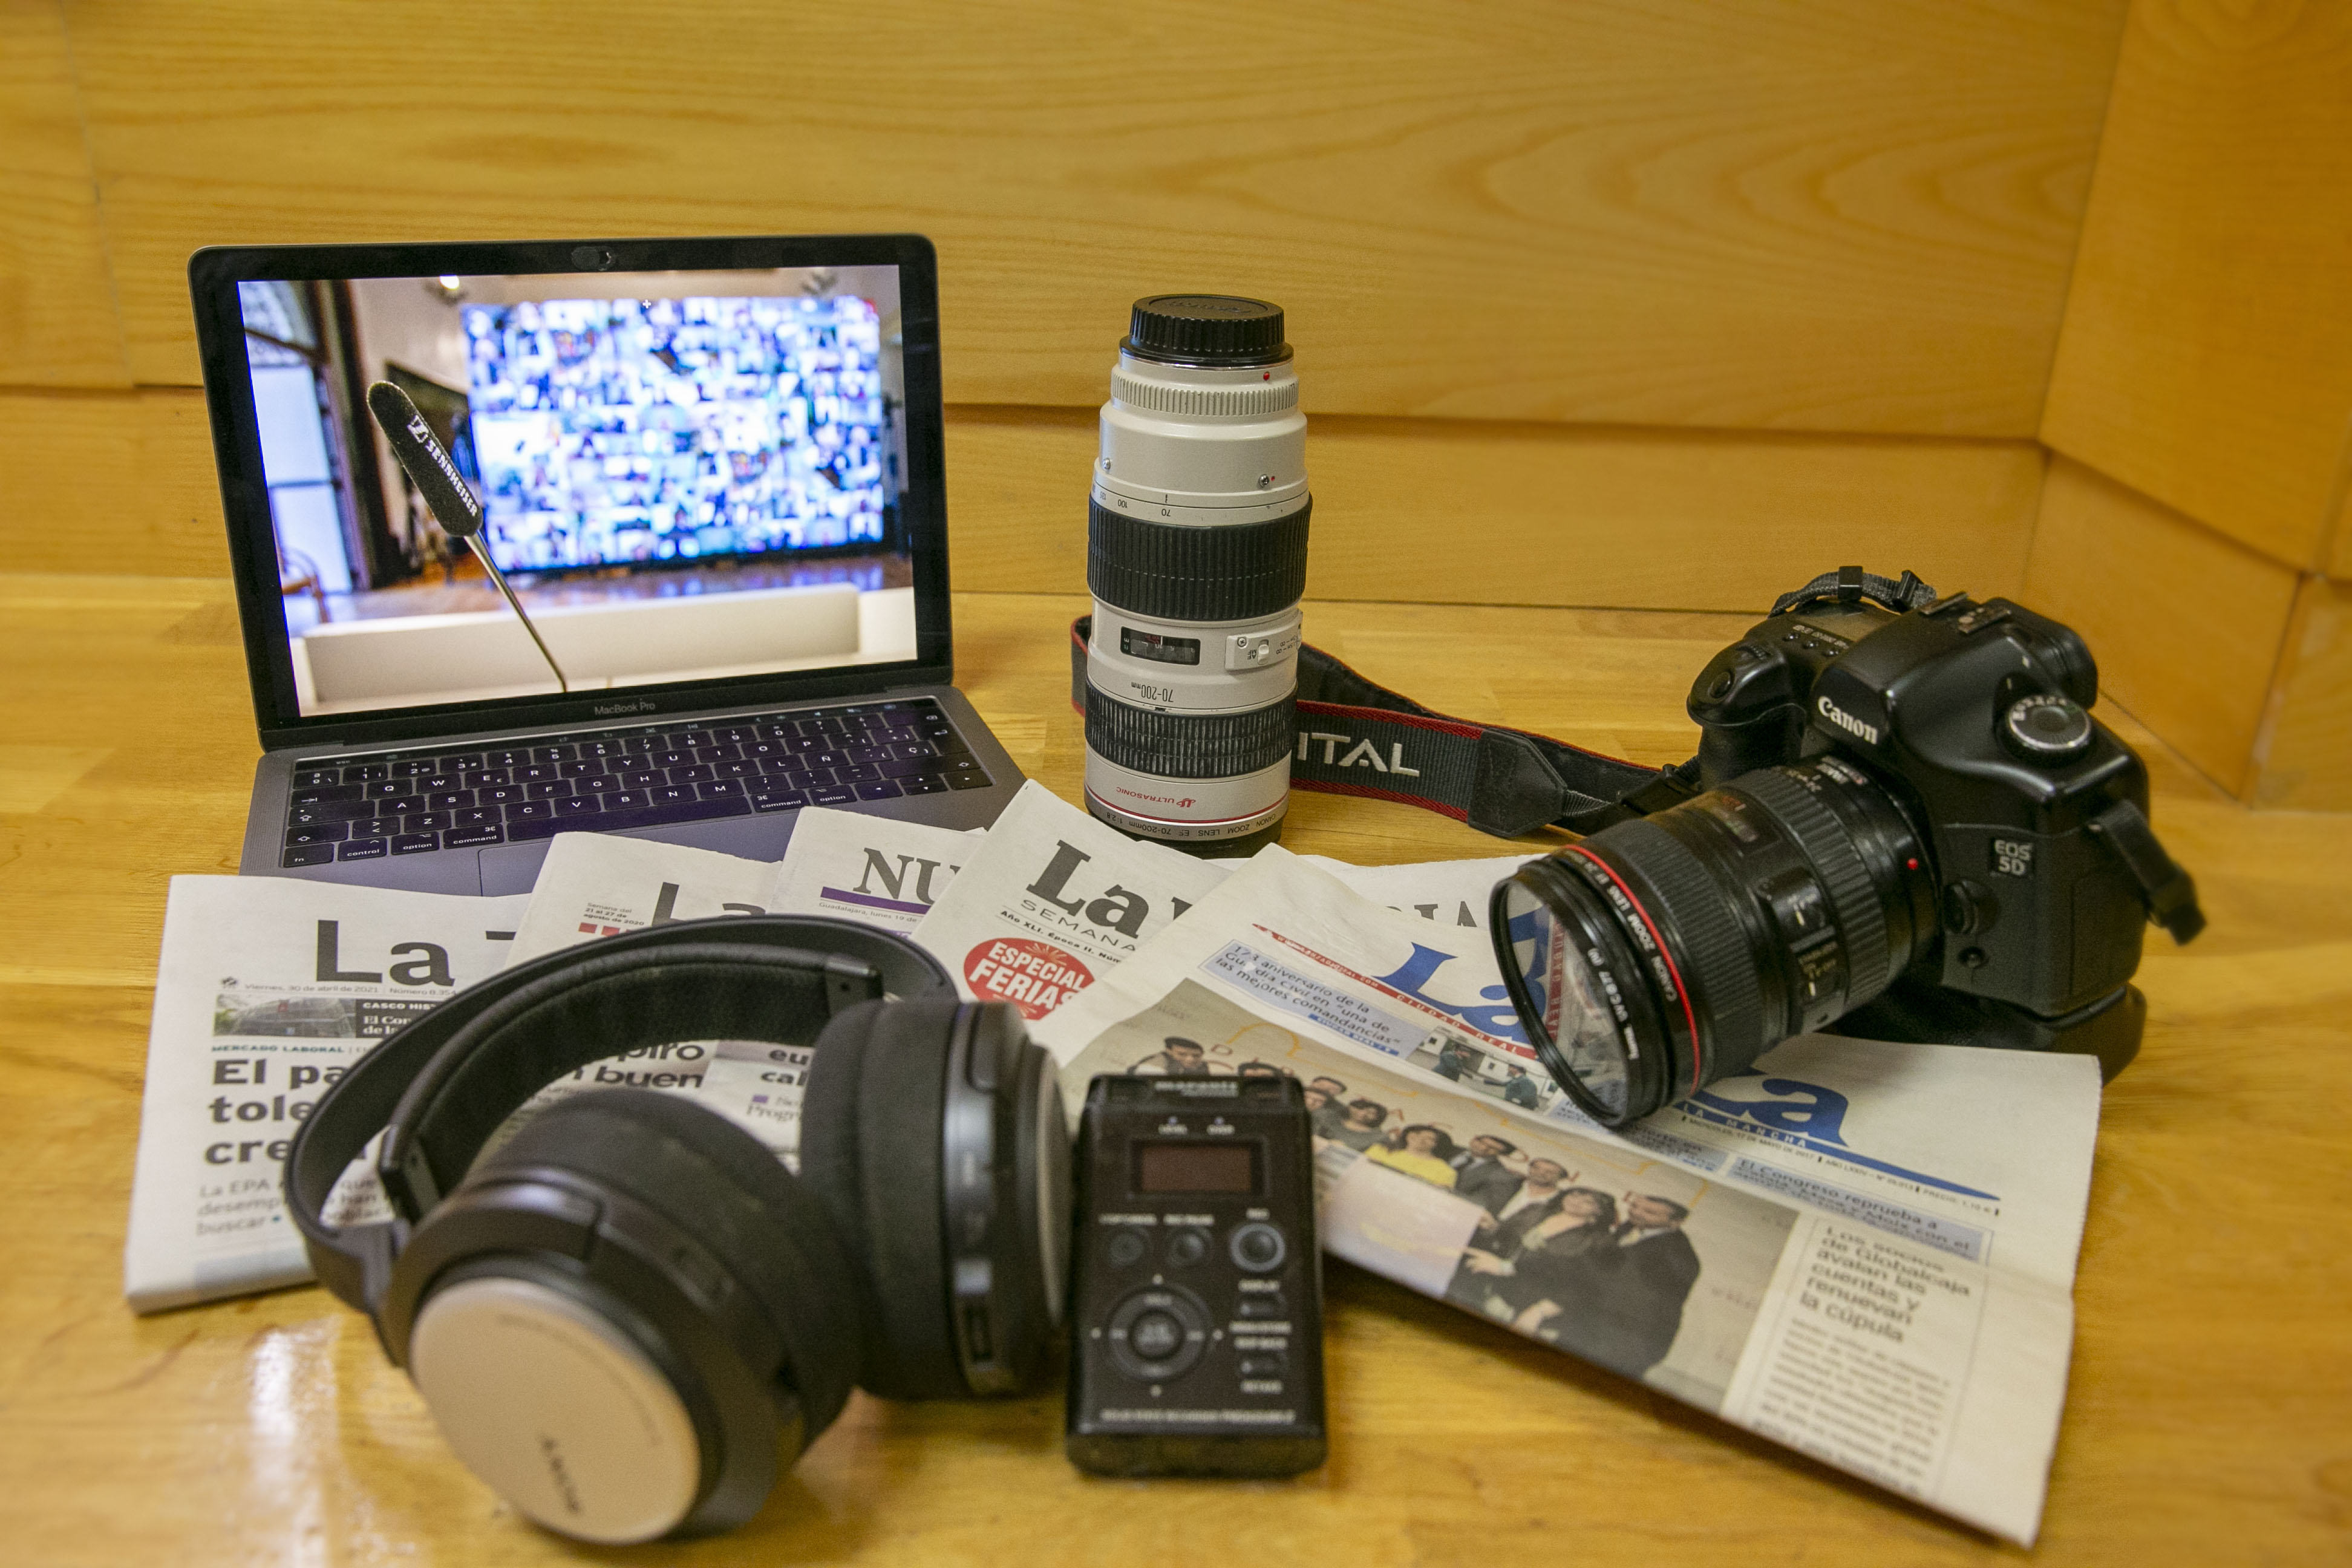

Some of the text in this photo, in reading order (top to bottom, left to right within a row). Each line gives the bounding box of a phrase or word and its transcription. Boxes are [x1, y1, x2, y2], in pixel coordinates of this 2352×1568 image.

[1117, 499, 1128, 508] 100
[1161, 508, 1171, 517] 70
[1131, 681, 1174, 703] 70-200mm
[594, 702, 656, 715] MacBook Pro
[1818, 696, 1878, 745] Canon
[1297, 731, 1420, 777] ITAL
[760, 799, 802, 809] command
[1116, 786, 1175, 804] ULTRASONIC
[1129, 821, 1171, 835] 70-200mm
[1227, 823, 1250, 834] ZOOM
[1256, 813, 1282, 827] CANON
[453, 835, 498, 844] command
[1198, 828, 1220, 836] LENS
[347, 849, 380, 857] control
[402, 843, 433, 852] option
[1994, 839, 2033, 861] EOS
[1998, 855, 2025, 876] 5D
[1025, 840, 1149, 939] La
[583, 912, 610, 922] agosto
[587, 902, 618, 912] Semana
[818, 901, 868, 916] Guadalajara,
[870, 910, 892, 920] lunes
[1001, 910, 1021, 923] Año
[1024, 922, 1044, 934] XLI.
[1048, 932, 1080, 948] Época
[1020, 900, 1136, 952] SEMANA
[1627, 912, 1656, 952] ZOOM
[315, 920, 456, 987] La
[987, 941, 1086, 991] ESPECIAL
[969, 958, 1074, 1011] FERIAS
[1215, 958, 1289, 1000] las mejores
[1260, 961, 1370, 1013] aniversario de la
[363, 1002, 405, 1010] CASCO
[1312, 995, 1330, 1007] en
[1371, 1019, 1391, 1033] de
[363, 1025, 382, 1035] de
[364, 1016, 377, 1025] El
[1396, 993, 1520, 1054] CIUDAD REAL
[213, 1058, 266, 1085] El
[595, 1067, 704, 1088] buen
[1725, 1119, 1807, 1148] MANCHA
[204, 1139, 292, 1165] cre
[200, 1179, 270, 1198] La EPA
[1759, 1165, 1838, 1197] Congreso
[1845, 1194, 1922, 1224] reprueba
[1821, 1238, 1848, 1252] de
[1816, 1247, 1926, 1296] avalan las
[1811, 1263, 1921, 1314] cuentas y
[1806, 1276, 1913, 1325] renuevan
[1800, 1289, 1904, 1343] la cúpula
